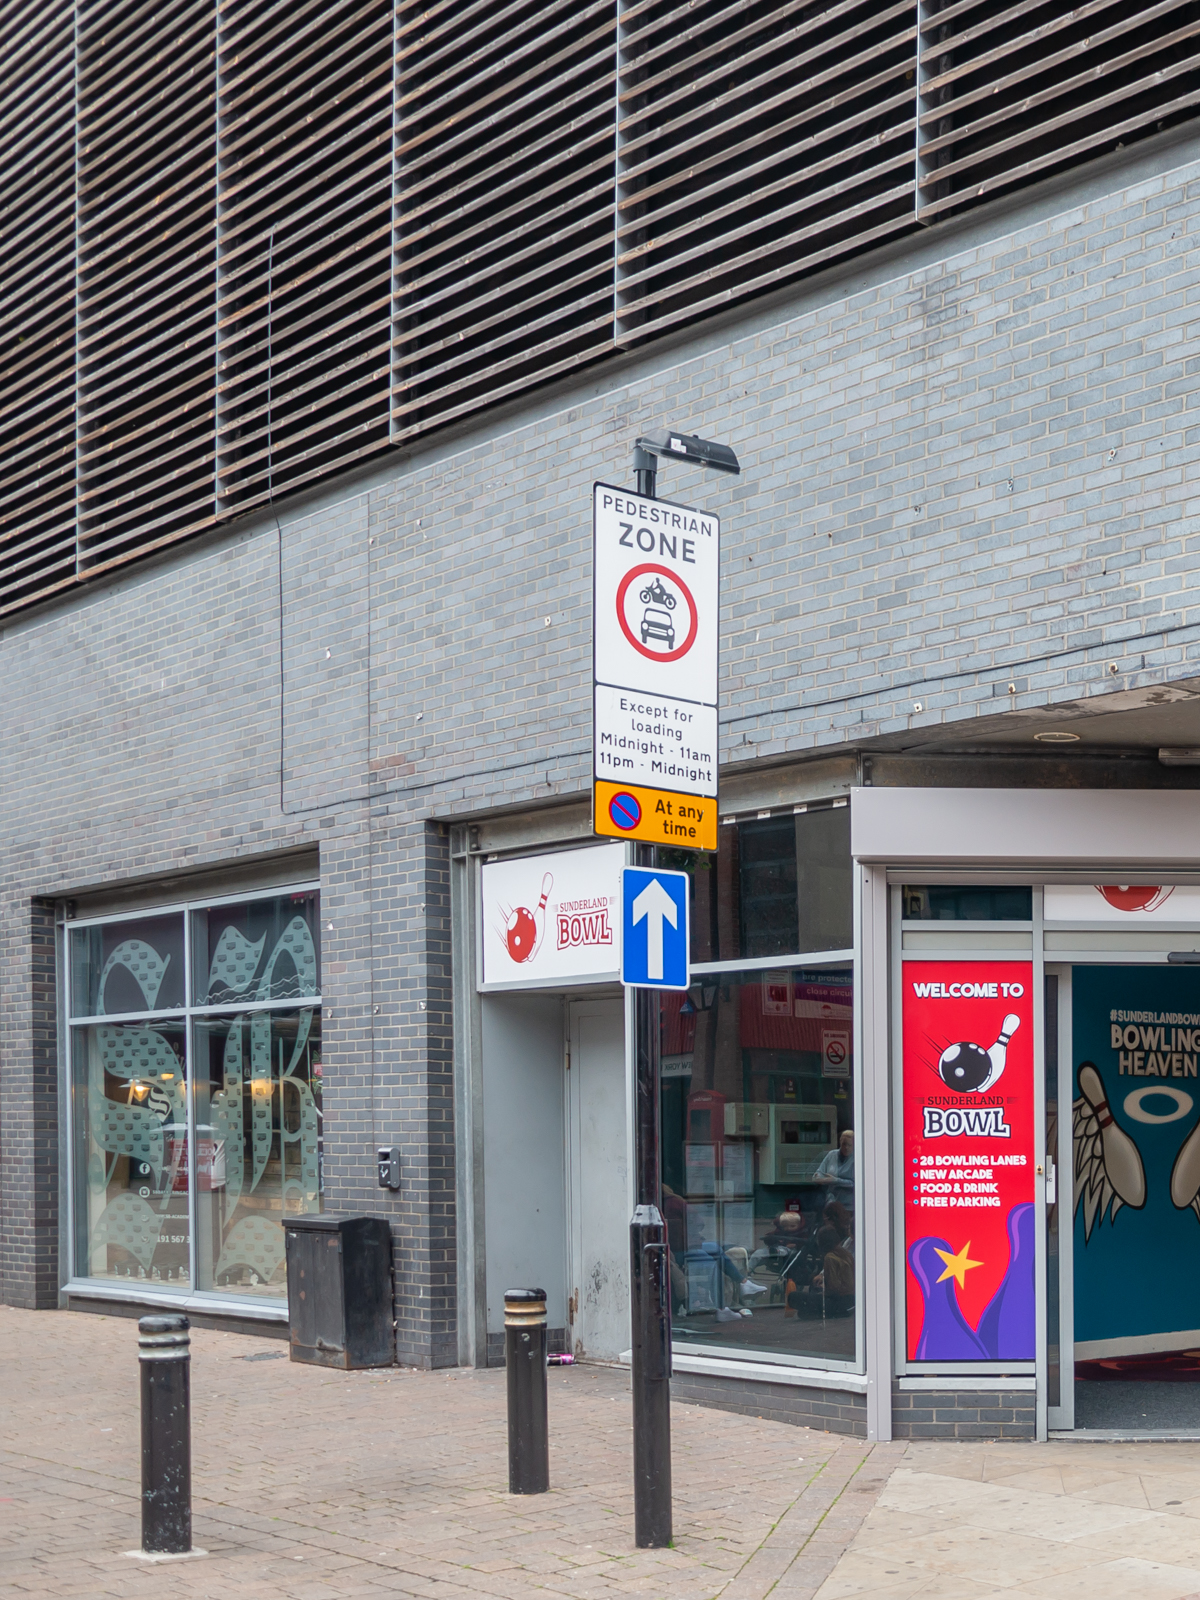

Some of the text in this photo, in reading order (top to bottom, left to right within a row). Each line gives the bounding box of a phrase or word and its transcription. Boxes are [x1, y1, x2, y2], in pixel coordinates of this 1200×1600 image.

[603, 494, 712, 537] PEDESTRIAN
[619, 521, 696, 564] ZONE
[620, 698, 693, 723] Except for
[631, 719, 683, 741] loading
[601, 732, 664, 755] Midnight
[680, 747, 711, 763] 11am
[600, 752, 634, 768] 11pm
[651, 760, 712, 782] Midnight
[655, 799, 704, 822] At any
[663, 820, 697, 838] time
[560, 896, 608, 913] SUNDERLAND
[557, 908, 613, 951] BOWL
[913, 983, 1024, 998] WELCOME TO
[1118, 1050, 1198, 1078] HEAVEN
[927, 1096, 1004, 1106] SUNDERLAND
[923, 1106, 1011, 1138] BOWL
[920, 1154, 1027, 1166] 28 BOWLING LANES
[920, 1169, 993, 1180] NEW ARCADE
[920, 1183, 999, 1193] FOOD & DRINK
[920, 1197, 1001, 1207] FREE PARKING
